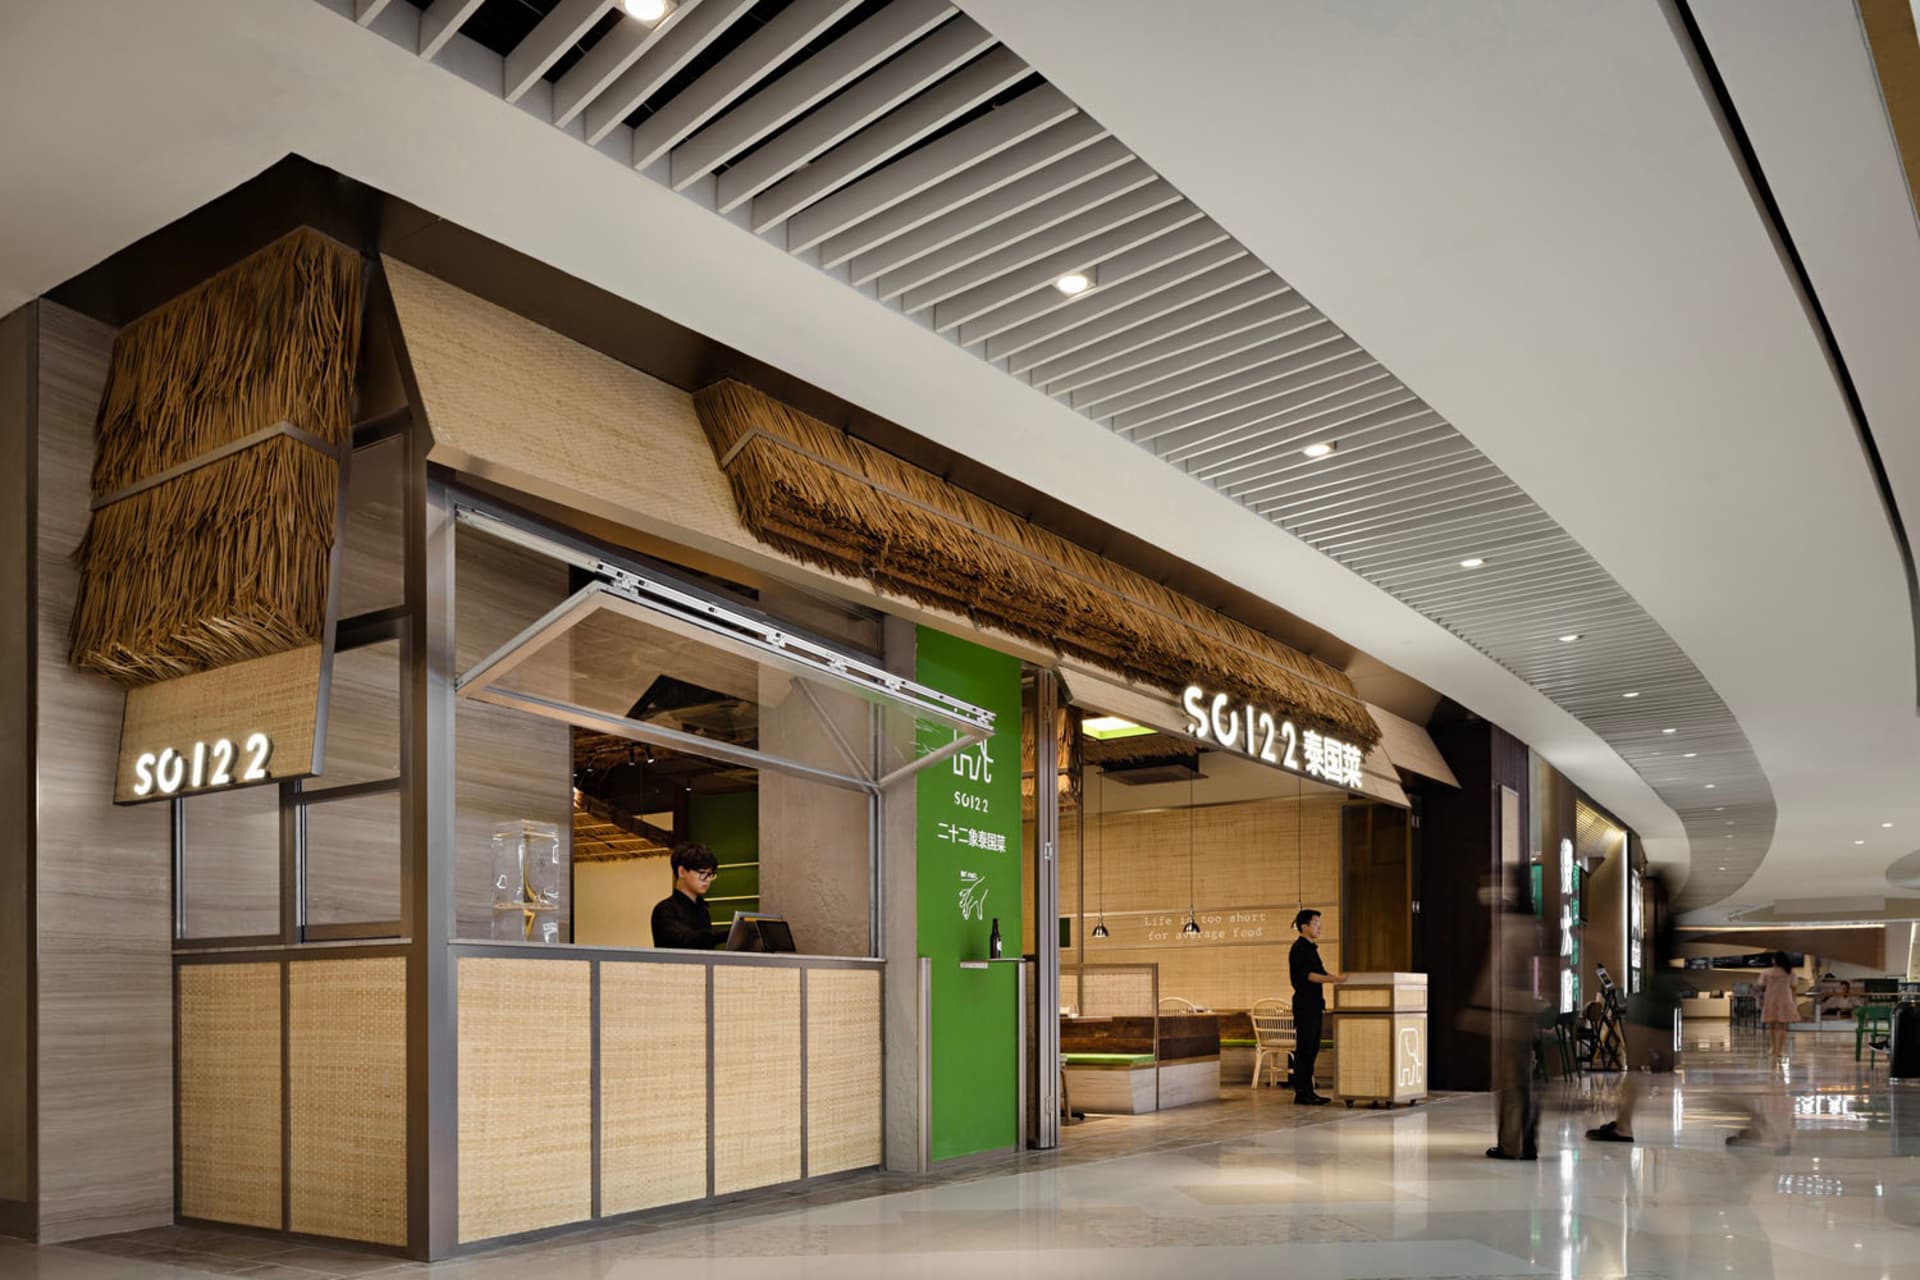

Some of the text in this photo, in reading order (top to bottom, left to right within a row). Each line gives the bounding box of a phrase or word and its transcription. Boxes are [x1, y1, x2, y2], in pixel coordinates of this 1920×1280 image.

[1302, 729, 1363, 789] 泰国菜
[1144, 915, 1172, 926] Life
[1201, 914, 1222, 925] too
[1229, 912, 1266, 923] short
[1148, 930, 1169, 941] for
[1234, 927, 1263, 938] food
